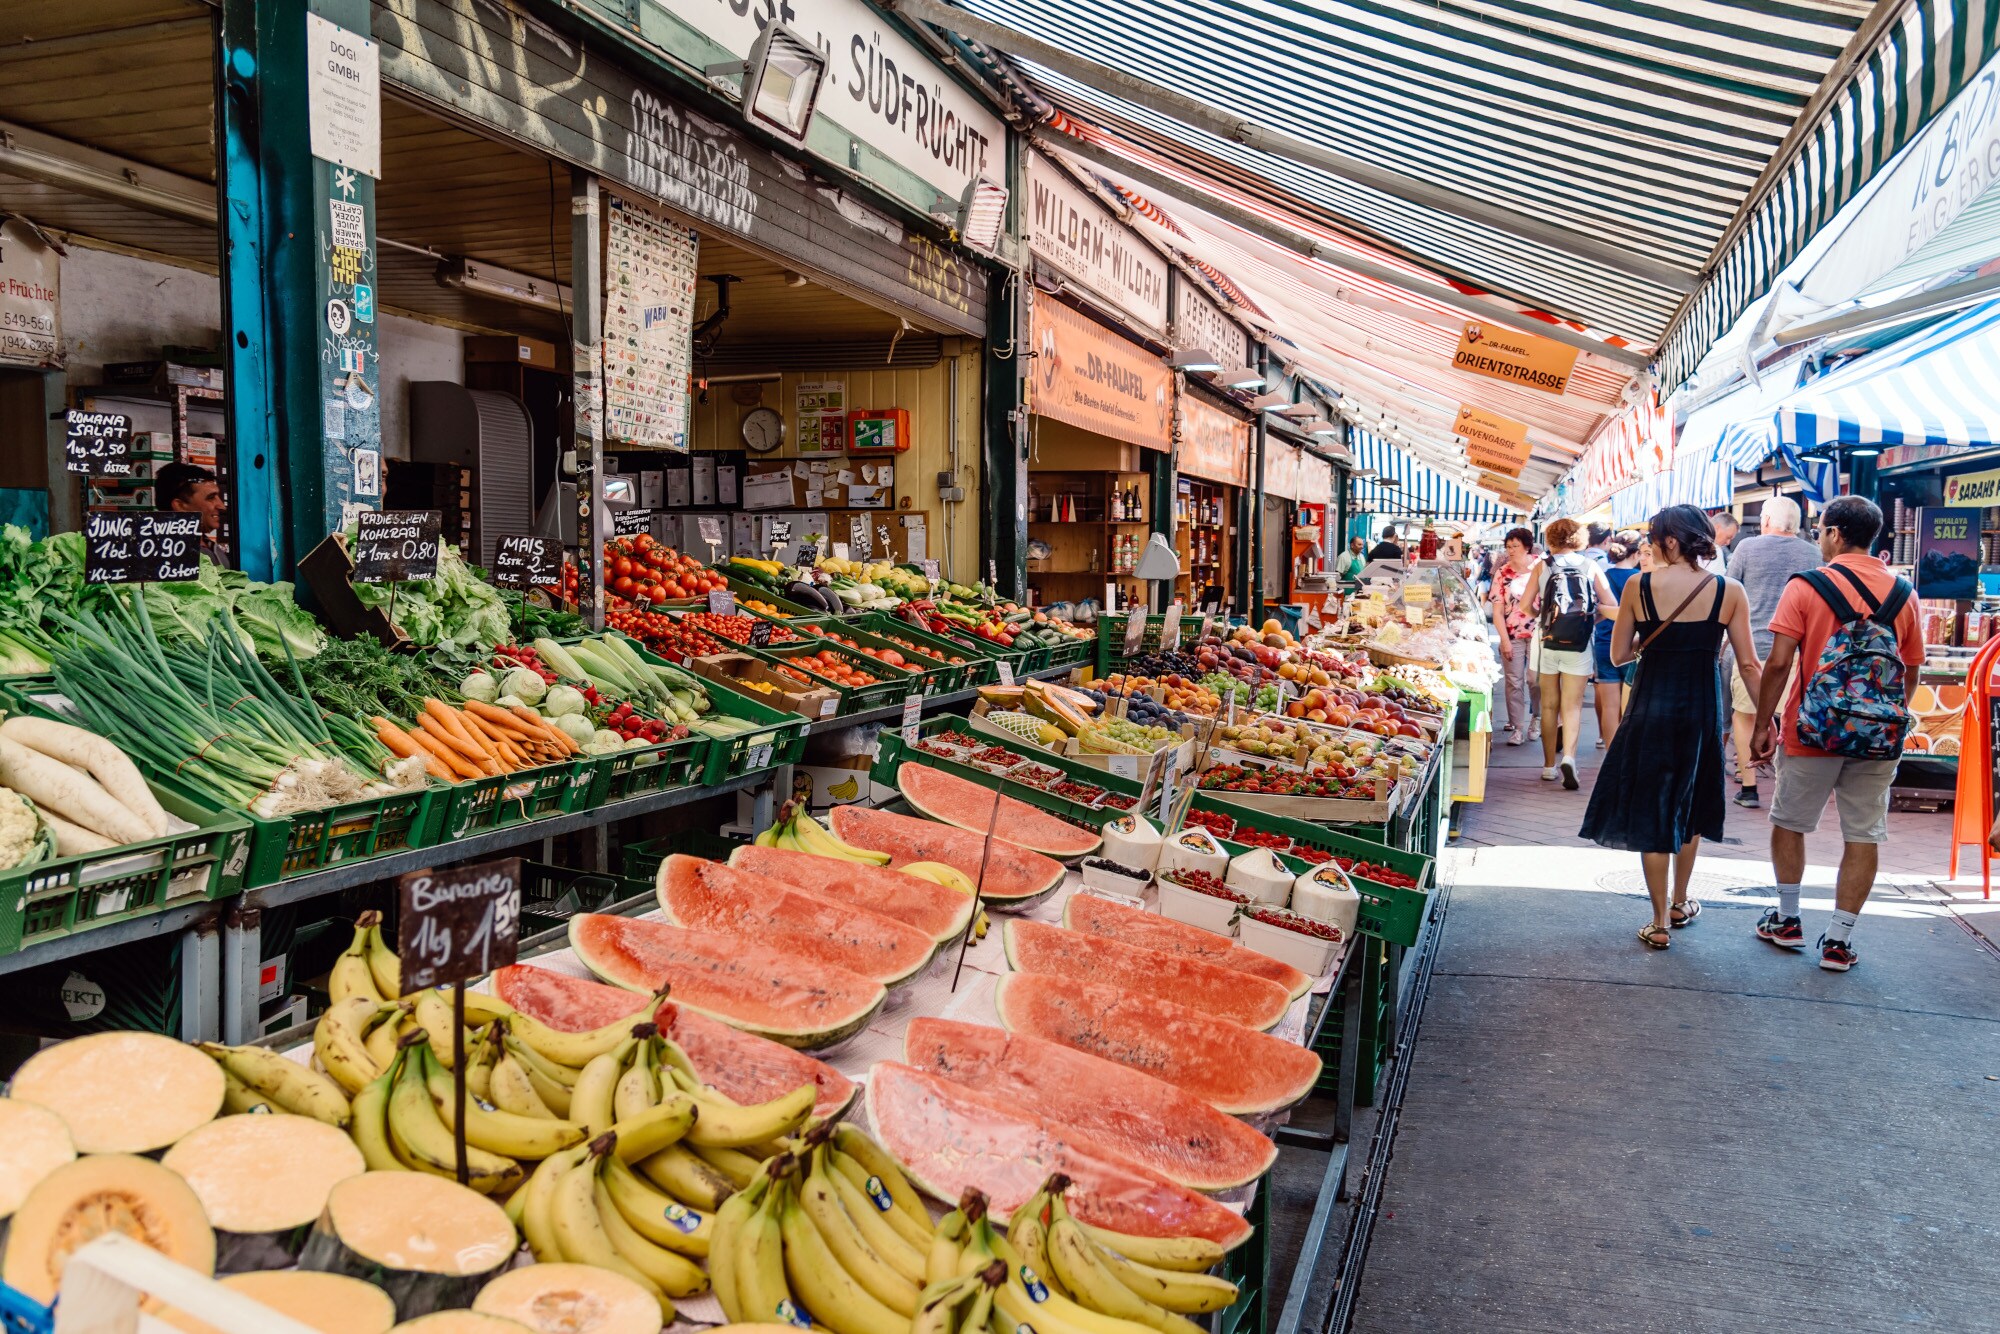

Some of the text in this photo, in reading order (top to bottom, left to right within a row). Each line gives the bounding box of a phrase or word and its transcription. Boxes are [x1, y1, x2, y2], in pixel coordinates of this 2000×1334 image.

[330, 40, 357, 62] DOGI
[328, 60, 361, 83] GMBH
[848, 31, 989, 177] SÜDFRÜCHTE
[337, 221, 360, 231] JUICE
[335, 237, 364, 249] SPACER
[1034, 178, 1161, 310] WILDAM-WILDAM
[1035, 231, 1055, 256] STAND
[9, 278, 54, 302] Früchte
[4, 312, 53, 332] 549-550
[644, 306, 667, 329] WABU
[2, 335, 27, 351] 1942
[1456, 351, 1566, 390] ORIENTSTRASSE
[67, 411, 125, 427] ROMANA
[68, 424, 128, 438] SALAT
[1459, 424, 1517, 450] OLIVENGASSE
[1958, 480, 1995, 501] SARAHS
[88, 514, 203, 538] JUNG ZWIEBEL
[1934, 517, 1968, 525] HIMALAYA
[360, 527, 420, 540] KOHLRABI
[1934, 525, 1967, 539] SALZ
[503, 537, 544, 556] MAIS
[411, 873, 513, 912] Bananen
